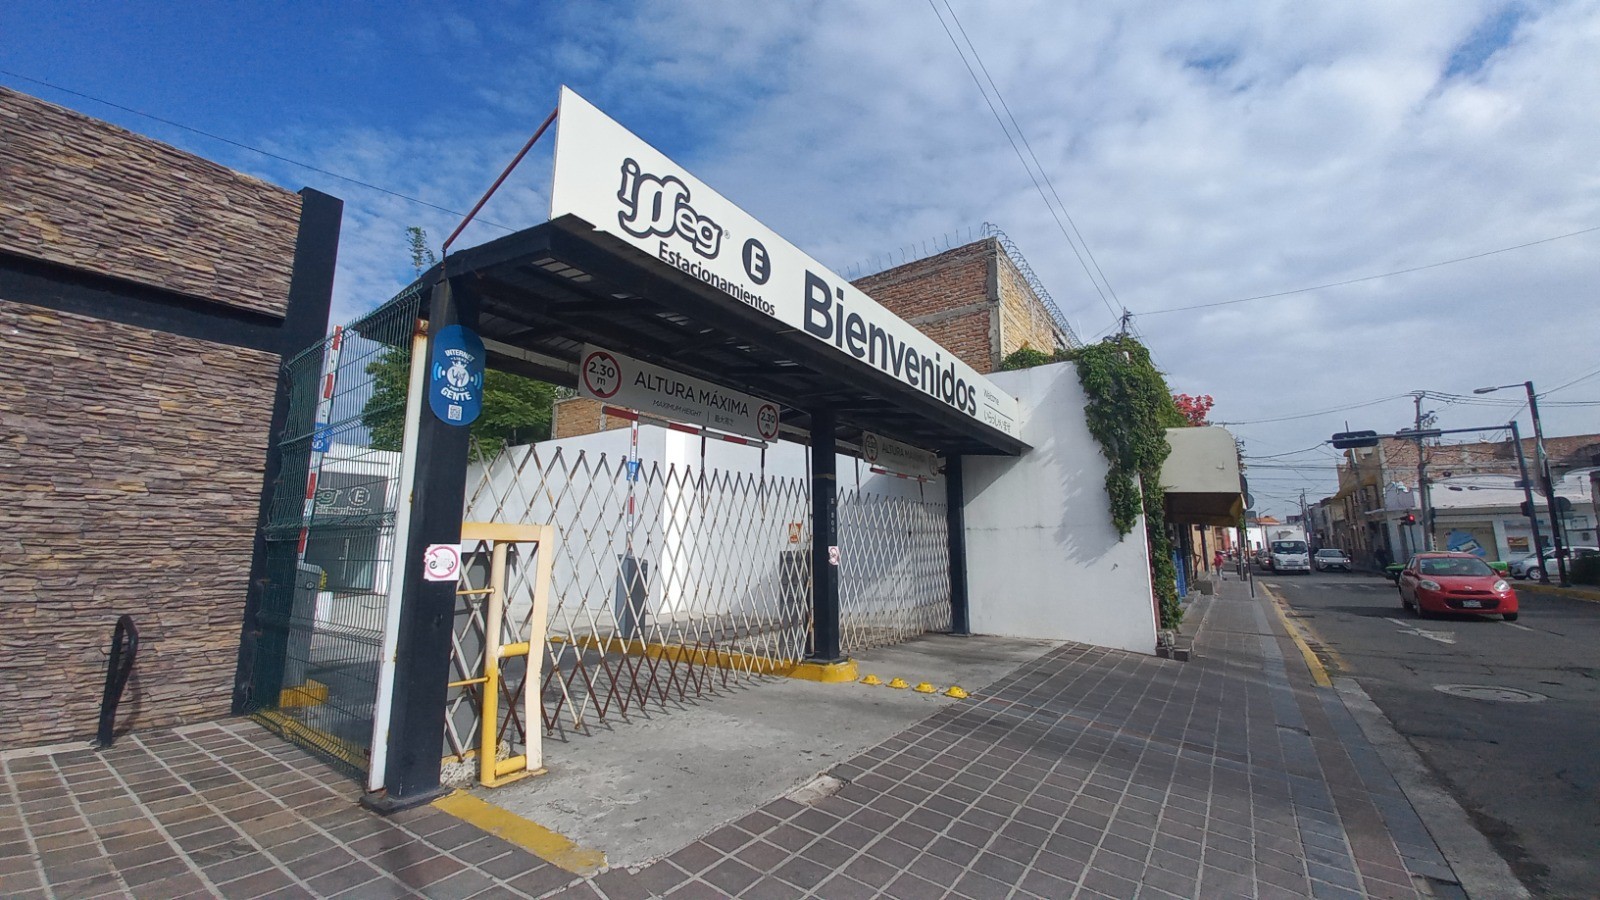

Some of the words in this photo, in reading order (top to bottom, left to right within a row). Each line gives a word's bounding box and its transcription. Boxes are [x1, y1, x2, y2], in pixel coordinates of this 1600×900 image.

[659, 240, 776, 316] Estacionamientos
[804, 268, 977, 417] Bienvenidos
[445, 348, 475, 362] INTERNET
[589, 361, 615, 378] 2.30
[597, 376, 606, 386] m
[440, 386, 472, 401] GENTE
[634, 370, 695, 402] ALTURA
[698, 389, 749, 418] MÁXIMA
[652, 399, 682, 411] MAXIMUM
[682, 407, 702, 417] HEIGHT
[761, 412, 776, 424] 2.30
